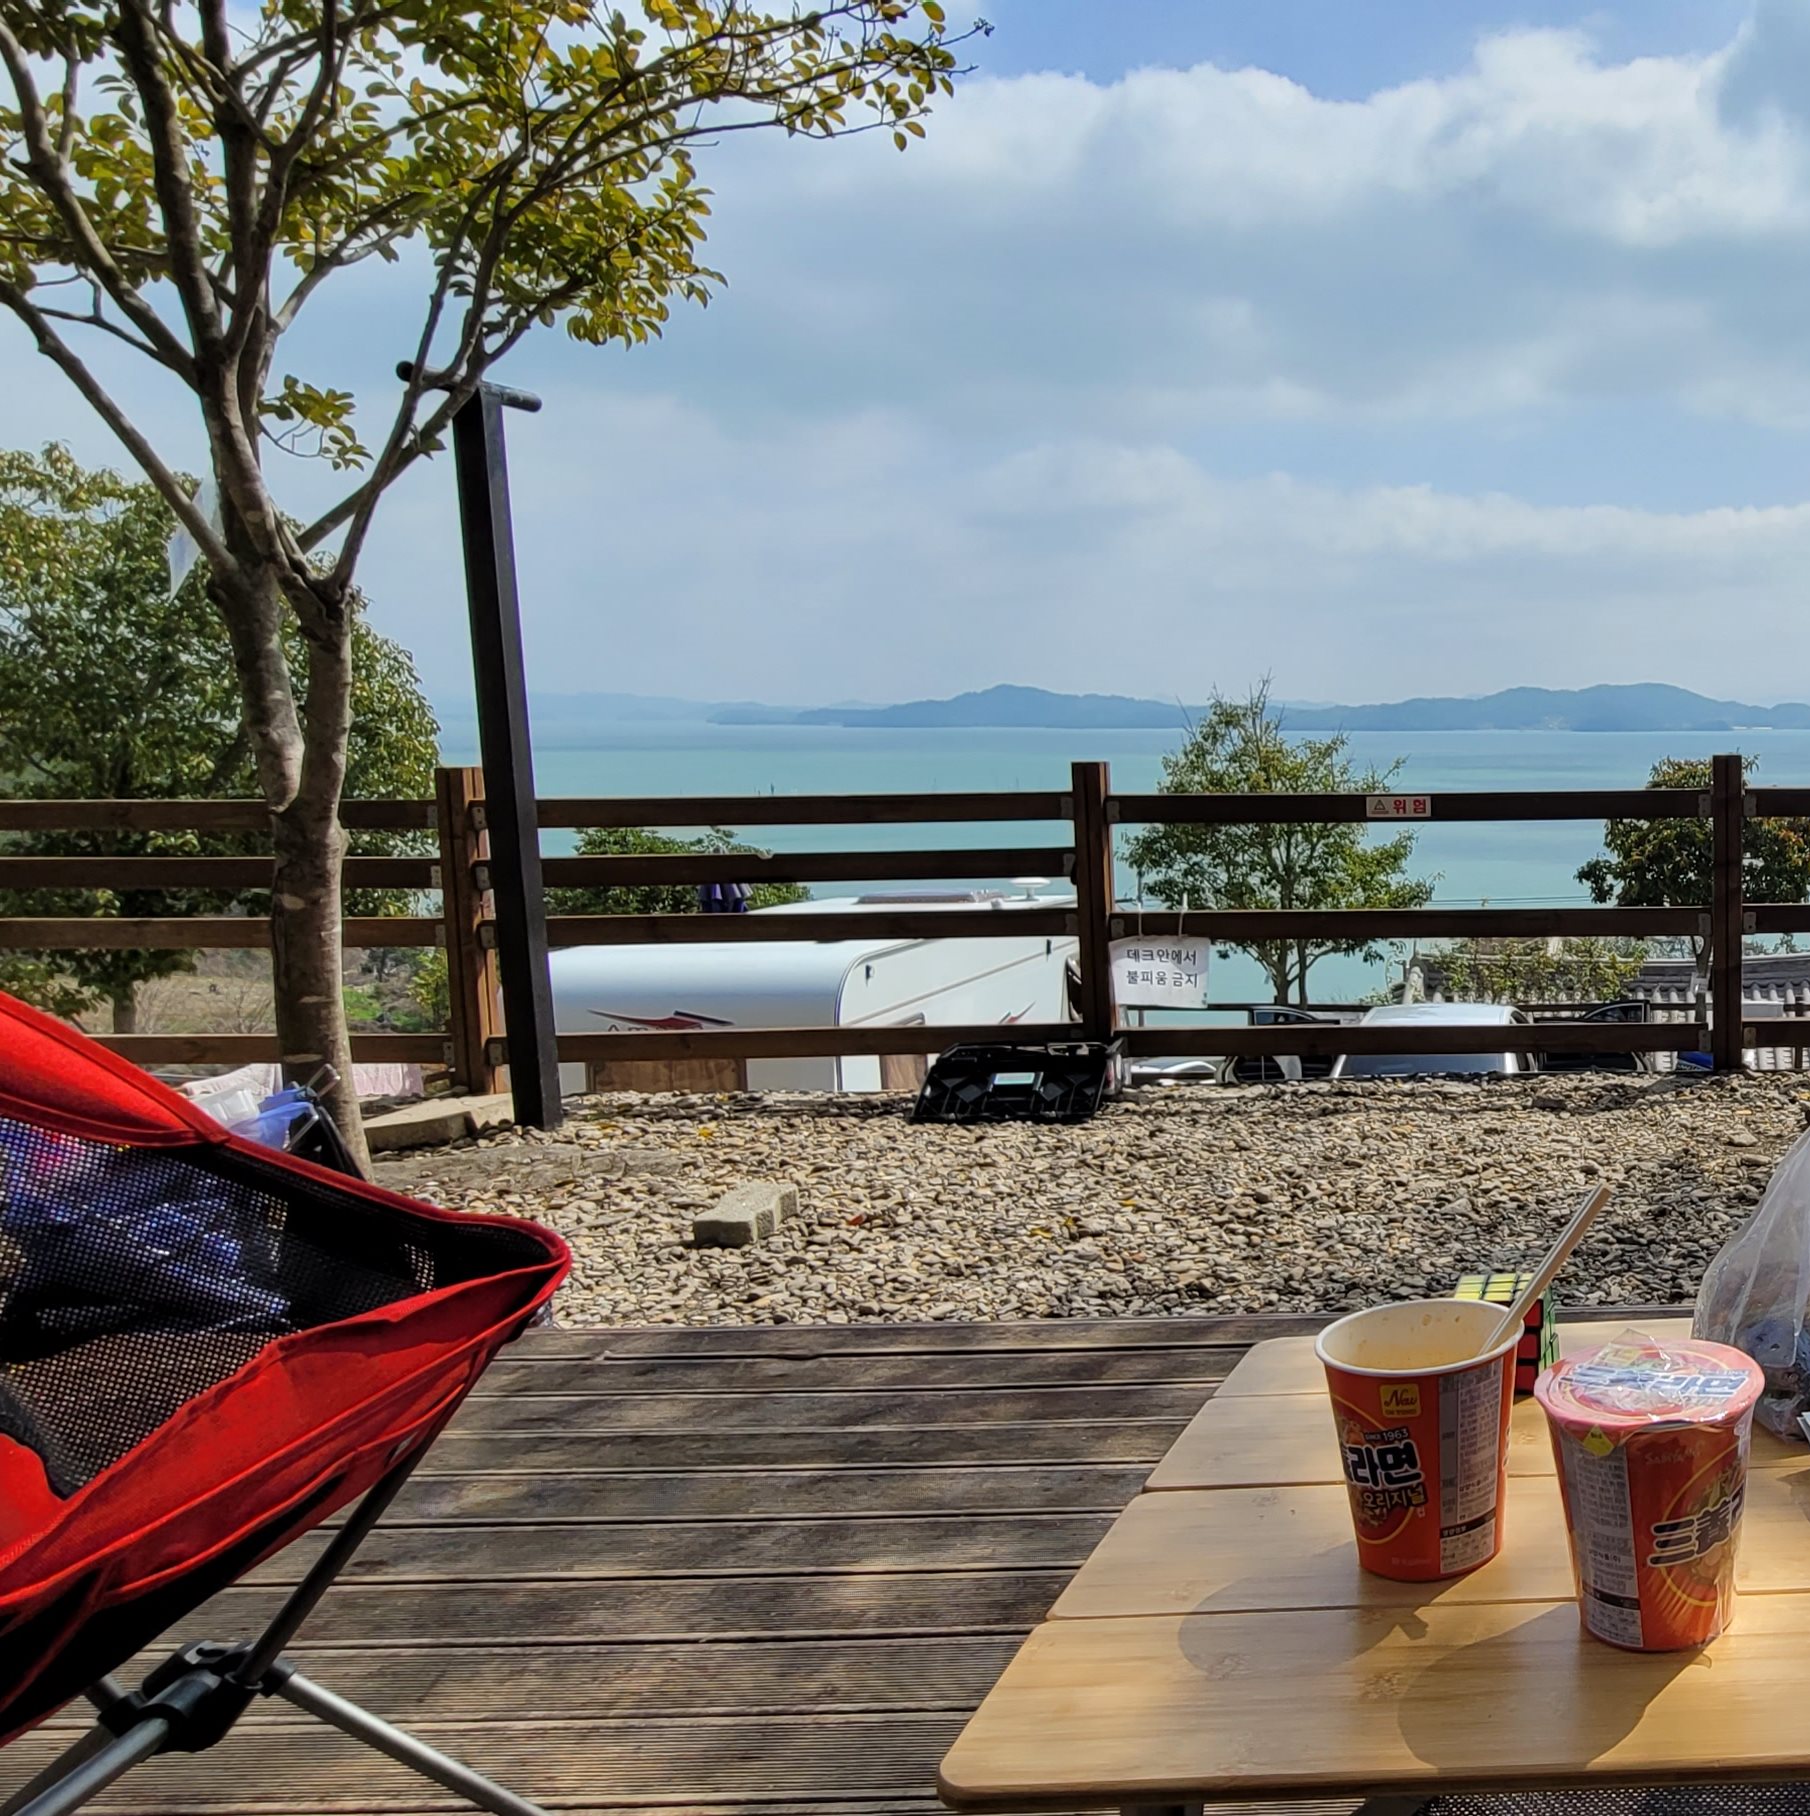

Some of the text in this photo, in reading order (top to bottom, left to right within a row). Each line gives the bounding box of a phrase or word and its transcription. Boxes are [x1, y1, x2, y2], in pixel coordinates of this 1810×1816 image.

[1126, 948, 1197, 965] 데크안에서
[1126, 970, 1198, 988] 불피움 금지
[1384, 1389, 1418, 1407] New
[1383, 1428, 1409, 1442] 1963
[1342, 1439, 1425, 1490] 라면
[1362, 1483, 1425, 1510] 오리지널
